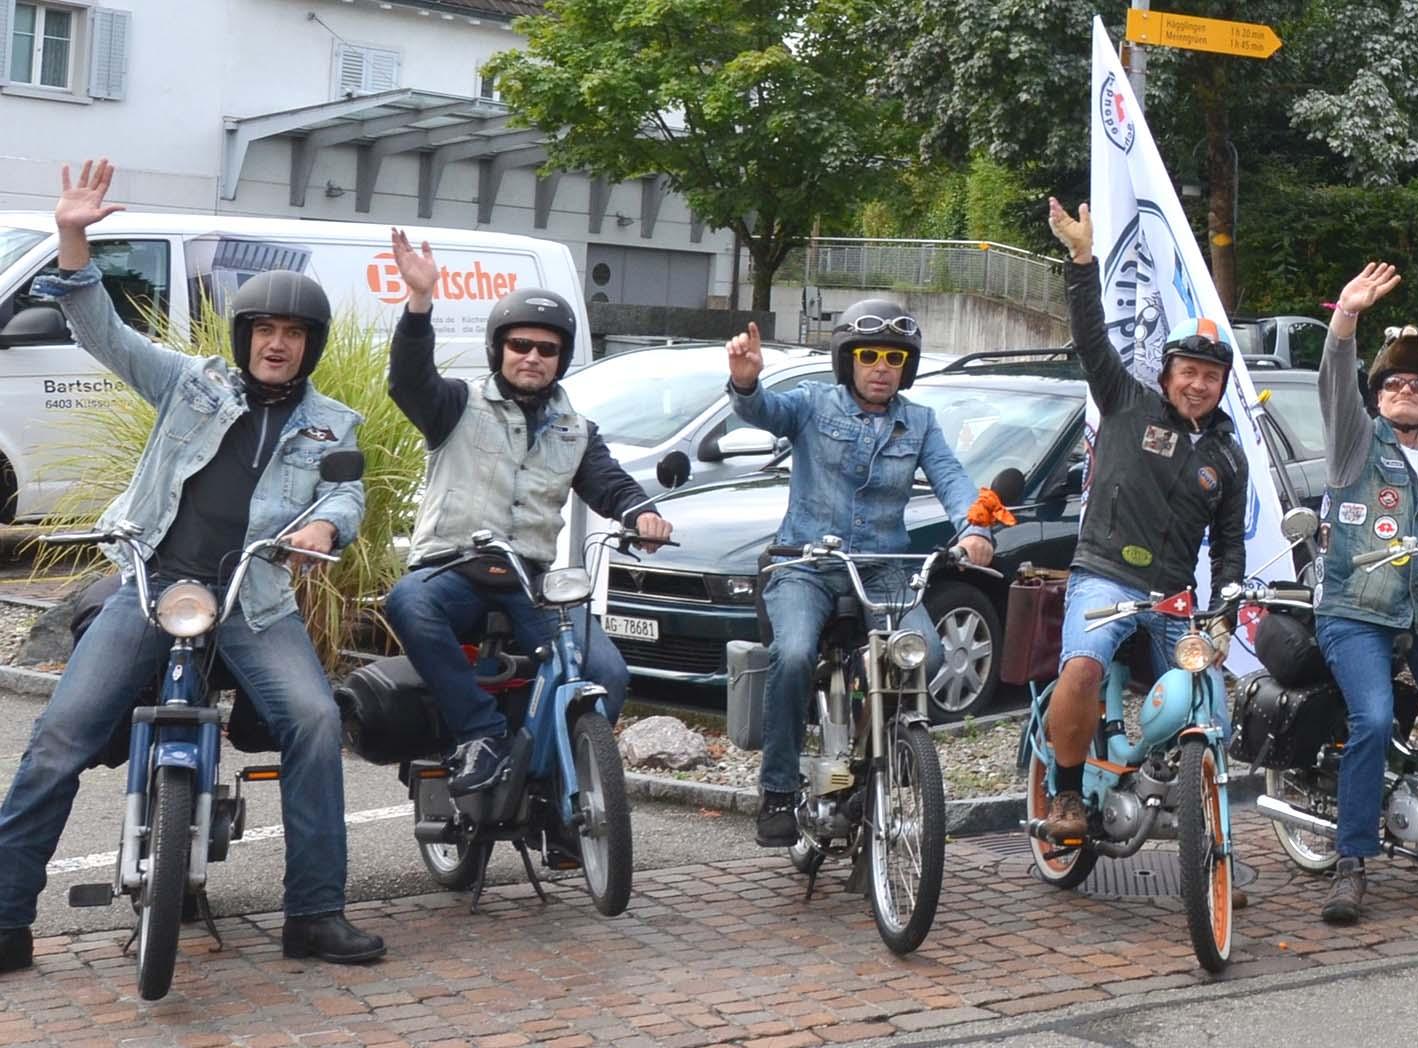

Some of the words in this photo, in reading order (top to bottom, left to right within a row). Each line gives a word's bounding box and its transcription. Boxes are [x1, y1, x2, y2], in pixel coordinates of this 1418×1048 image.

[367, 253, 517, 304] Brtscher
[44, 378, 125, 393] Bartsche
[45, 399, 73, 409] 6403
